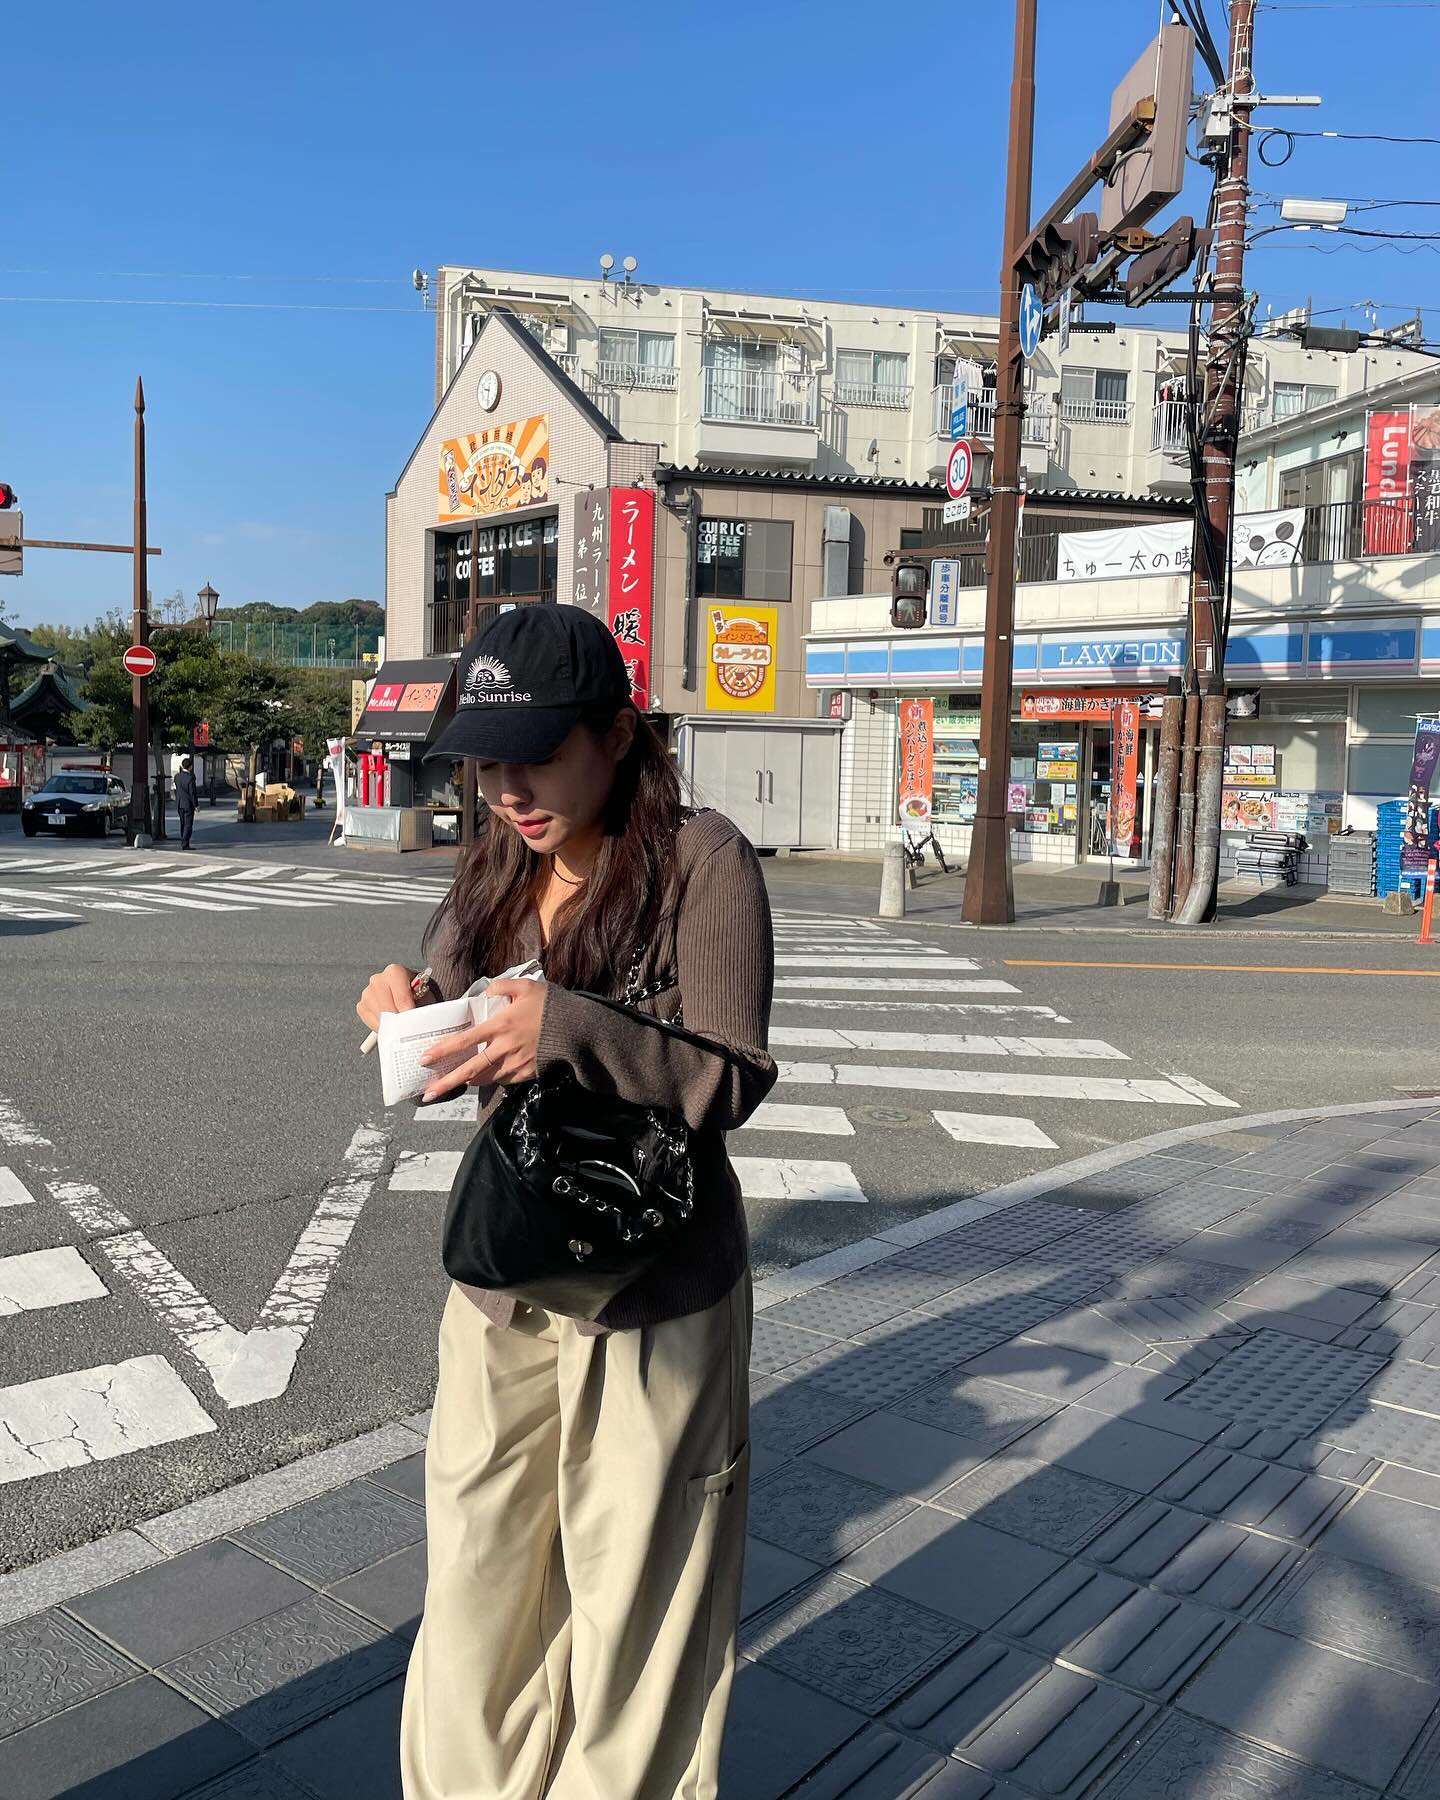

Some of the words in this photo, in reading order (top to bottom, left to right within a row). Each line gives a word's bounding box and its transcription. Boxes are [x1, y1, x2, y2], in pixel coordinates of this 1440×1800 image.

[460, 459, 521, 498] インダス
[951, 456, 966, 483] 30
[471, 497, 510, 513] カレーライス
[945, 502, 968, 518] ここから
[456, 530, 495, 556] CURY
[498, 523, 533, 550] RICE
[620, 500, 640, 593] ラーメン
[455, 556, 495, 580] COEE
[575, 538, 588, 602] 第一位
[591, 502, 605, 620] 九州ラーメ
[938, 563, 951, 623] 歩車分離信号
[1058, 641, 1182, 666] LAWSON
[368, 698, 397, 708] Mr.Kebab
[478, 691, 532, 703] Sunrise
[1061, 696, 1127, 712] 海鮮かき
[905, 721, 916, 791] ハンバーグごはん
[1239, 791, 1273, 803] どーん!
[1029, 813, 1045, 821] ATM
